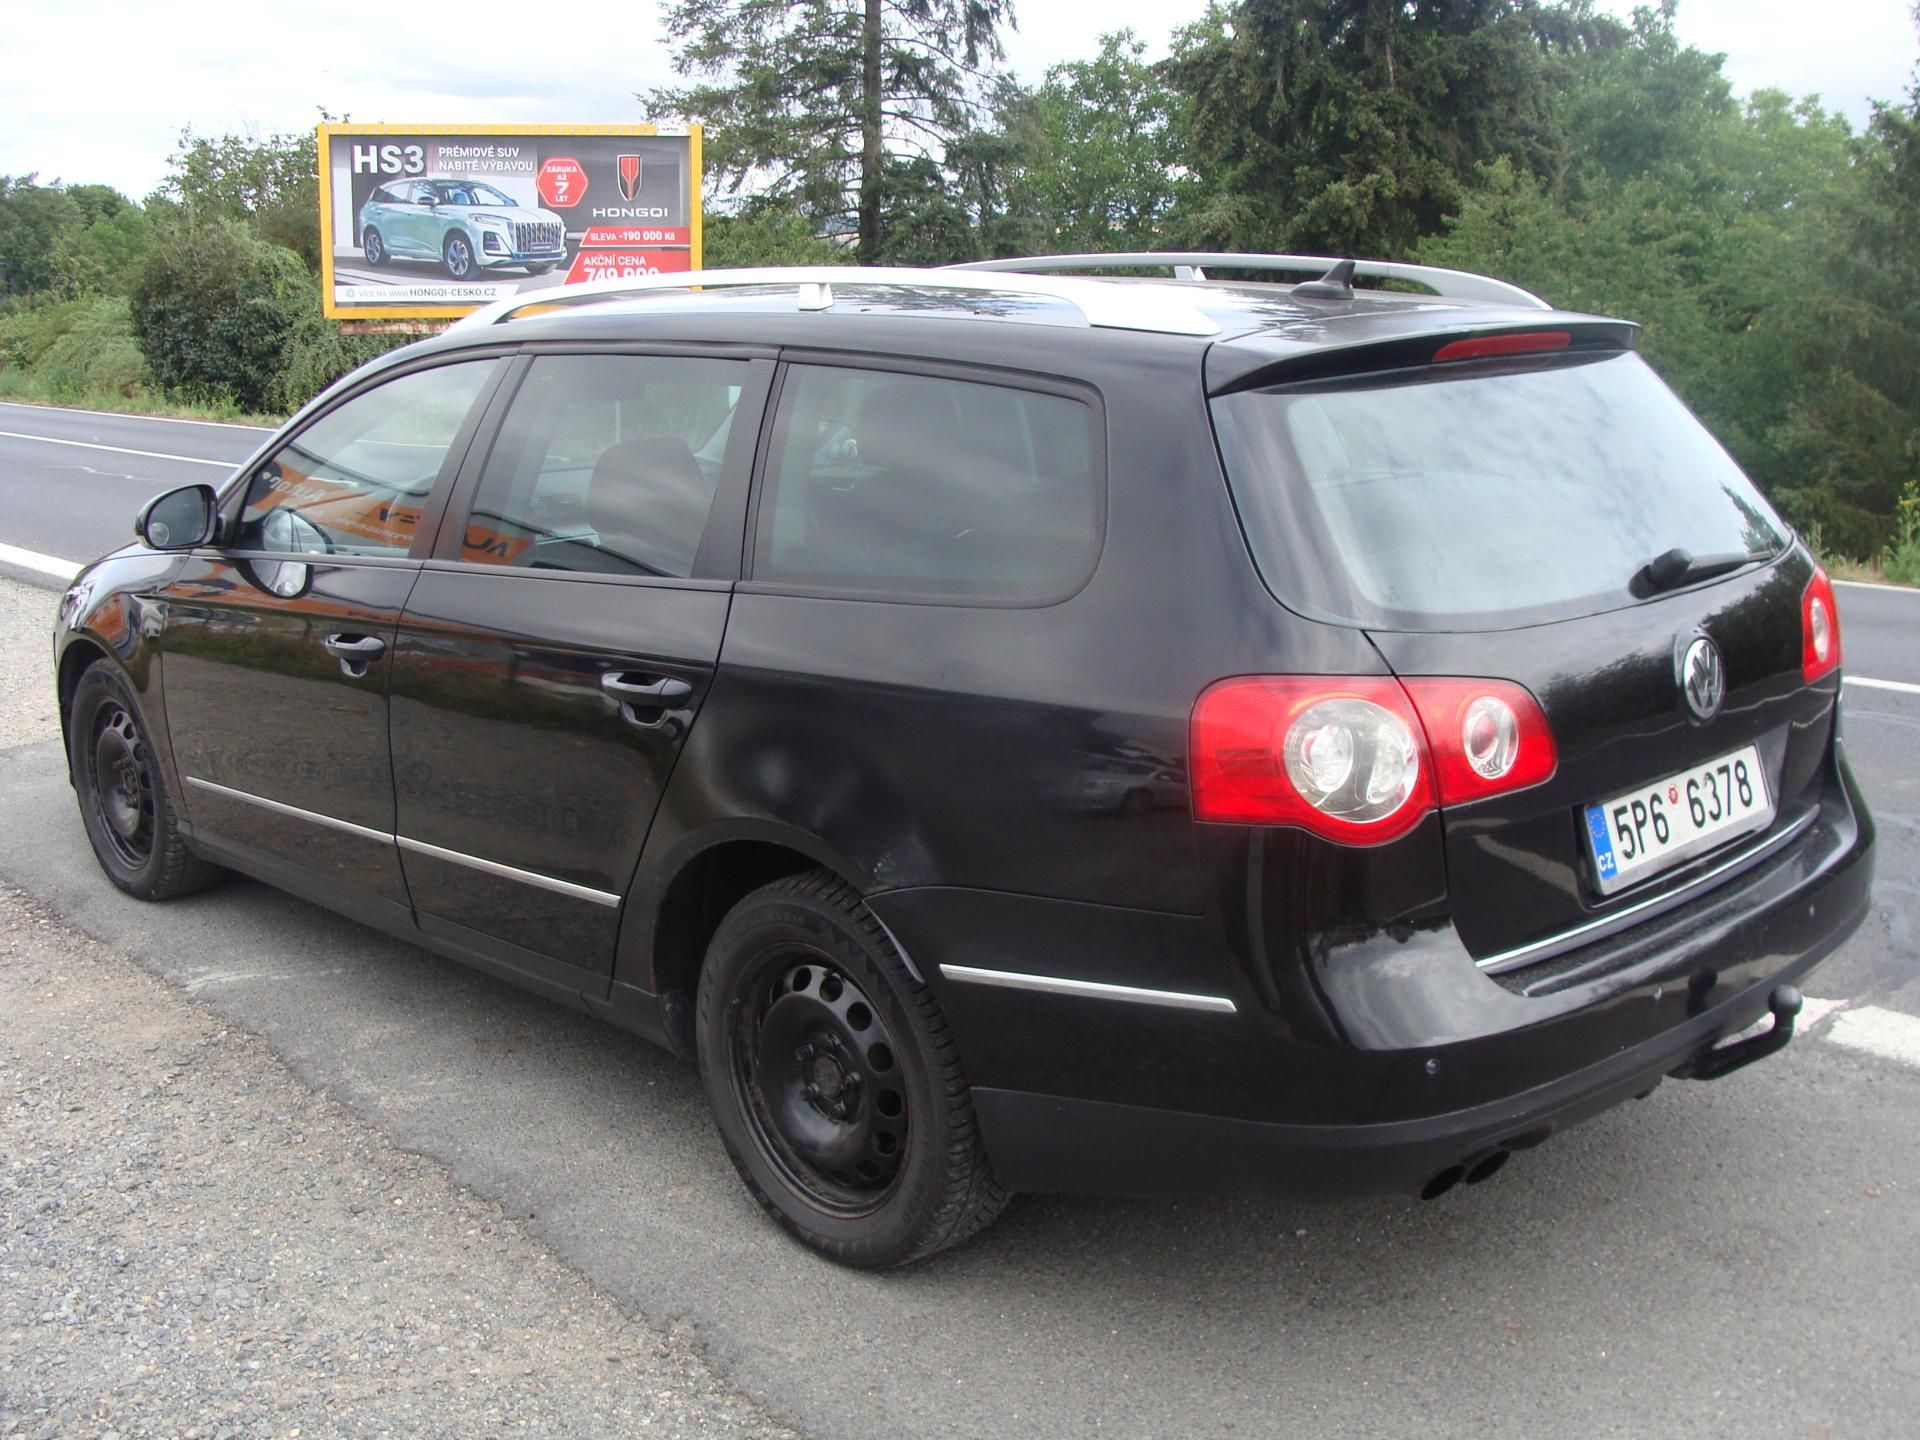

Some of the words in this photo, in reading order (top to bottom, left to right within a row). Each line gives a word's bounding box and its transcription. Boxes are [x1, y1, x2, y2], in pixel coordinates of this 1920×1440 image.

[438, 145, 495, 159] PRÉMIOVÉ
[497, 147, 520, 158] SUV
[354, 145, 424, 174] HS3
[438, 158, 479, 172] NABITÉ
[482, 158, 534, 172] VÝBAVOU
[555, 182, 569, 194] 7
[592, 207, 669, 218] HONGQI
[590, 231, 617, 241] SLEVA
[619, 231, 640, 241] -190
[642, 231, 663, 241] 000
[664, 231, 676, 241] Kč
[583, 254, 615, 266] AKČNÍ
[618, 256, 647, 266] CENA
[1612, 792, 1670, 860] 5P6
[1686, 759, 1754, 829] 6378
[1597, 851, 1615, 872] CZ
